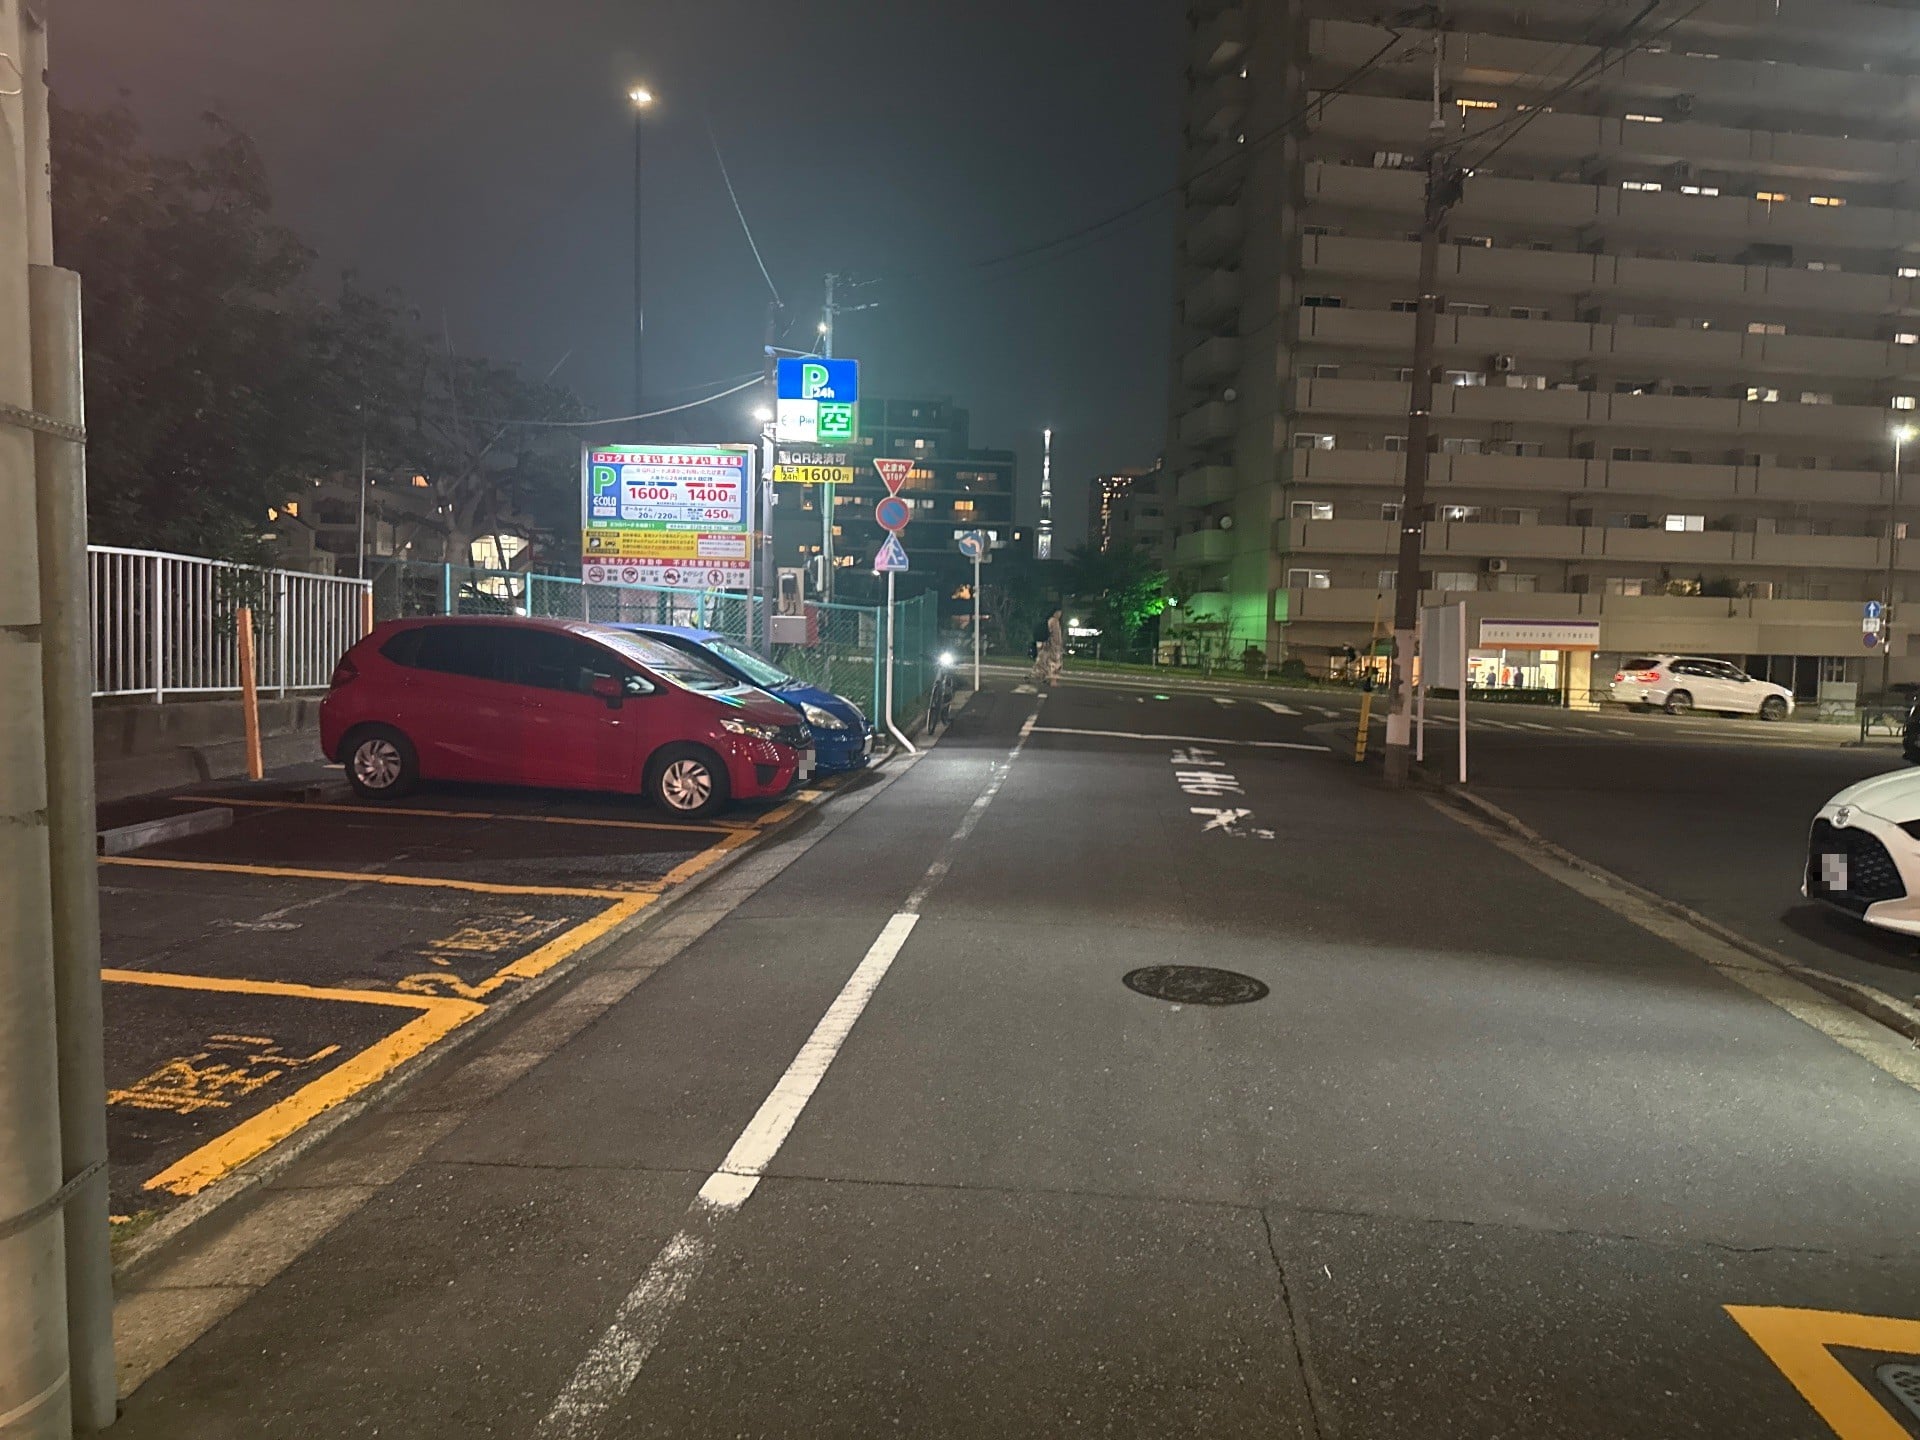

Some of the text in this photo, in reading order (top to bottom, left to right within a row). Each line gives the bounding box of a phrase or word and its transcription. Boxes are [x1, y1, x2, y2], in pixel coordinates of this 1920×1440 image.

[802, 364, 829, 399] P
[813, 387, 835, 399] 24h
[820, 403, 851, 437] 空
[792, 452, 846, 465] QR決済可
[882, 463, 906, 472] 止まれ
[594, 466, 616, 495] P
[782, 473, 798, 481] 24h
[600, 557, 663, 566] 監視カメラ作動中
